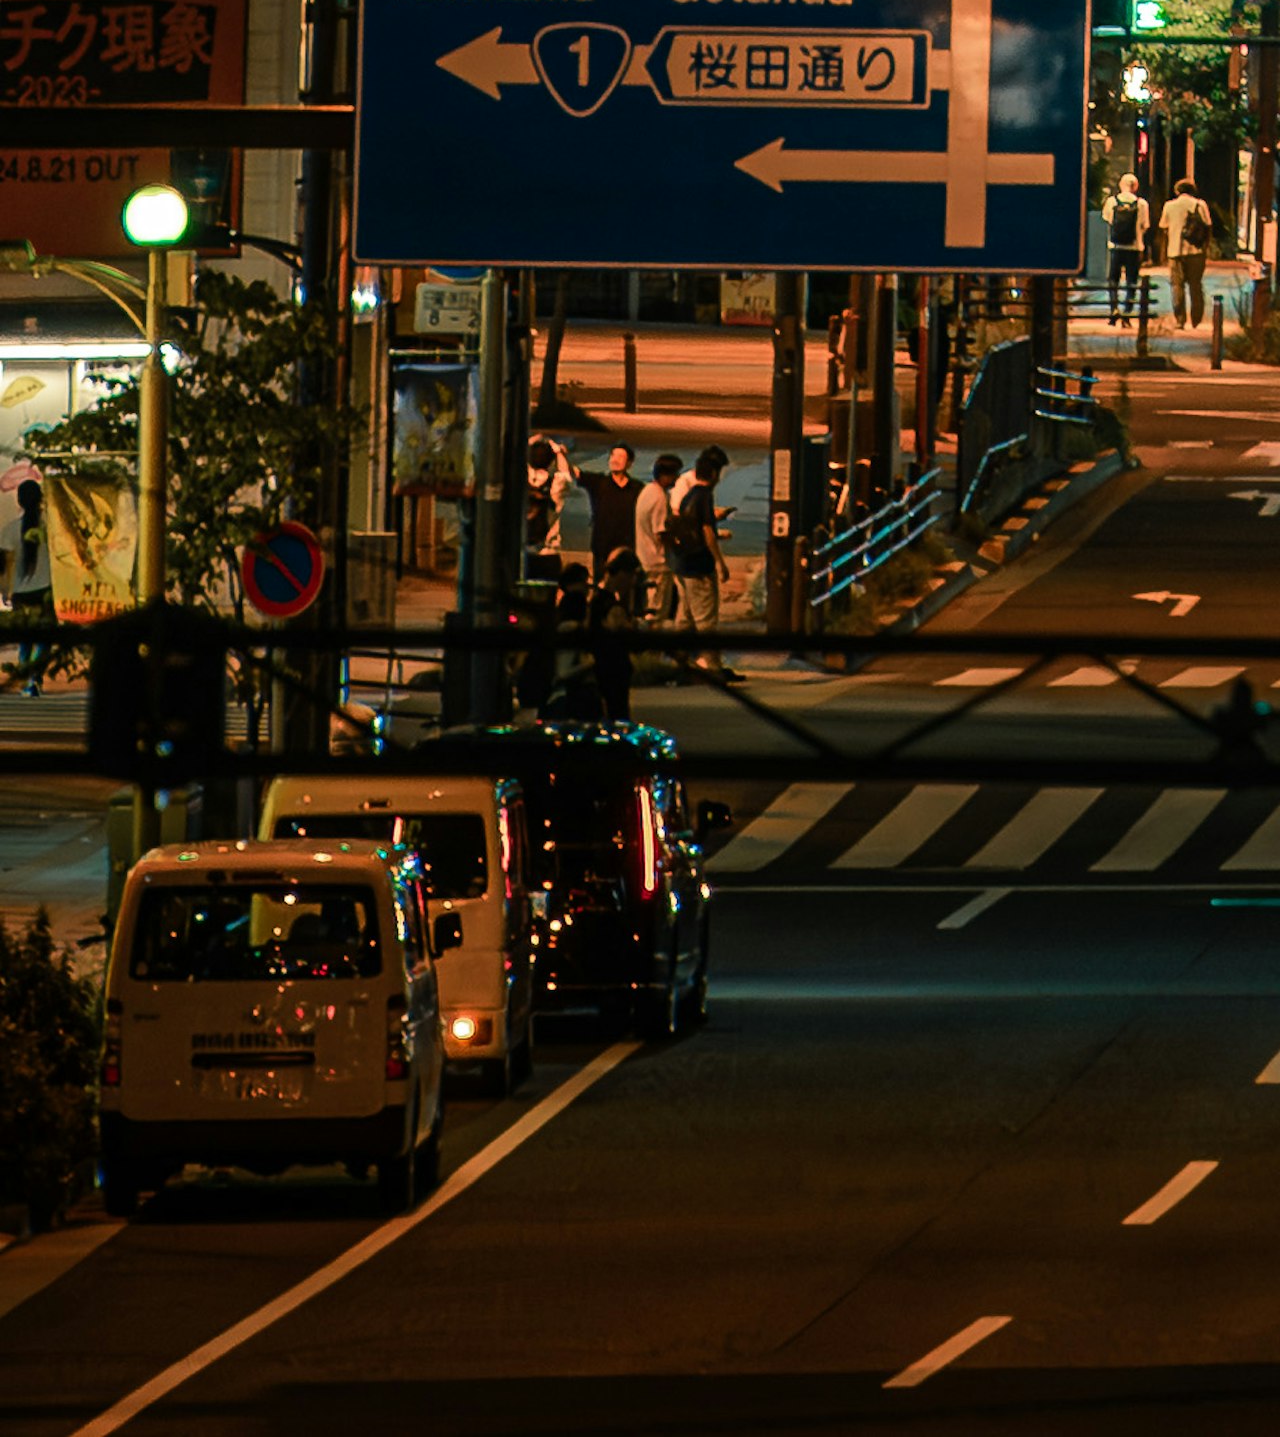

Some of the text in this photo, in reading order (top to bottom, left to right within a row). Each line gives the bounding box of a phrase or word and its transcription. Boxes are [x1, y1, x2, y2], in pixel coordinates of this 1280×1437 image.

[568, 35, 591, 88] 1
[688, 45, 897, 93] 桜田通り
[85, 155, 139, 181] OUT
